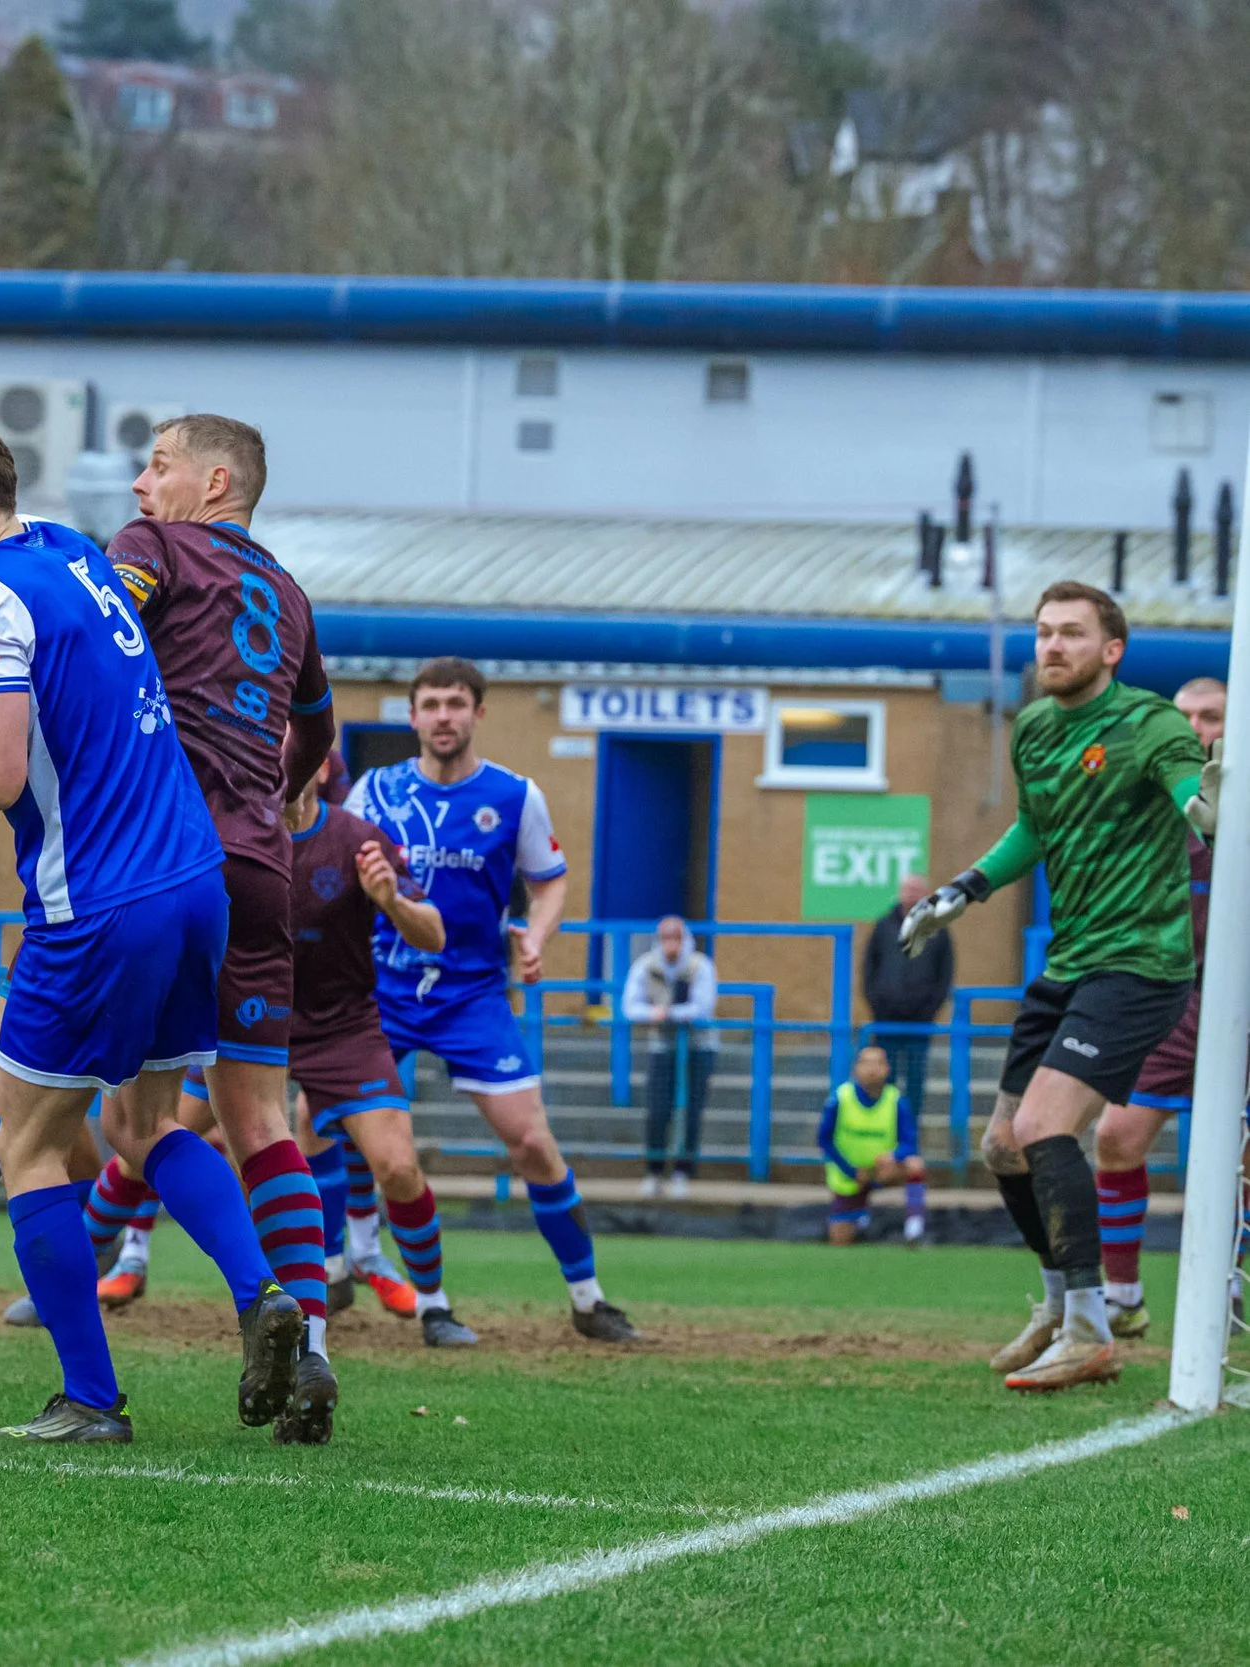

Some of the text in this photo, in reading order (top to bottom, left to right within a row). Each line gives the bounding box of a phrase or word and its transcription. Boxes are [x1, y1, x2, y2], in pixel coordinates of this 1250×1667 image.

[68, 556, 144, 657] 5
[231, 572, 283, 675] 8
[575, 689, 756, 723] TOILETS
[435, 801, 450, 829] 7
[813, 845, 919, 886] EXIT
